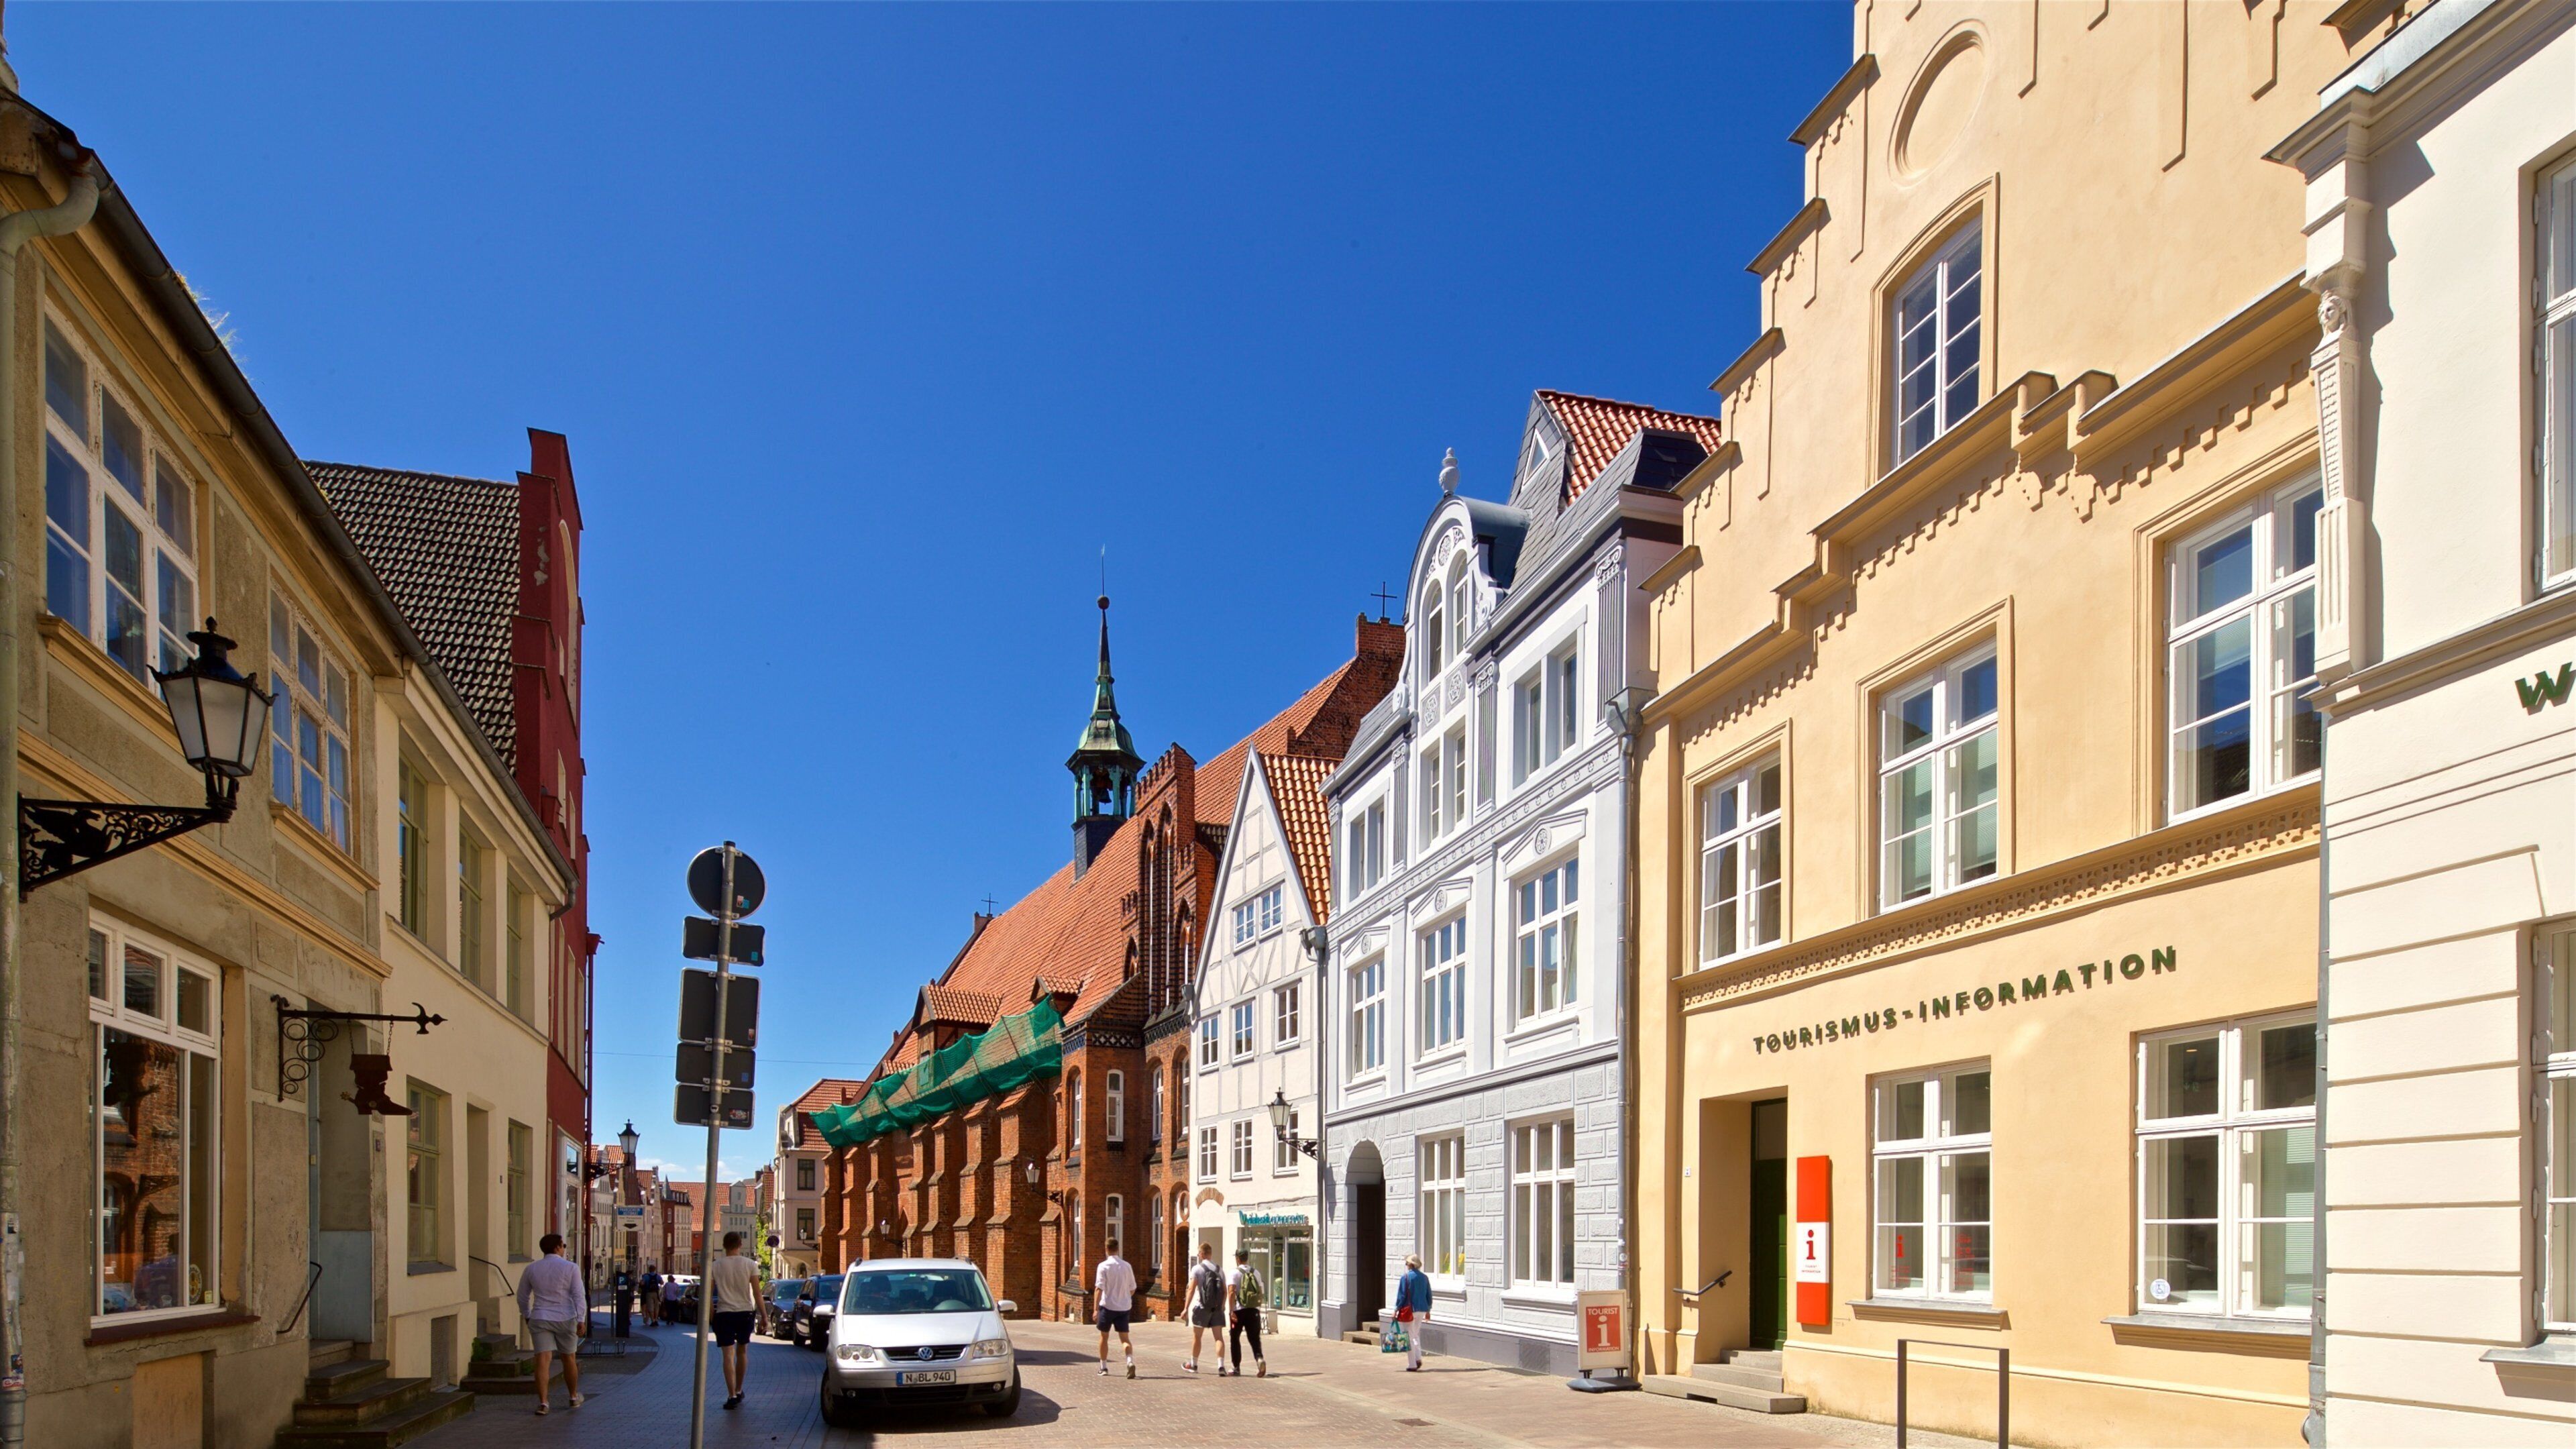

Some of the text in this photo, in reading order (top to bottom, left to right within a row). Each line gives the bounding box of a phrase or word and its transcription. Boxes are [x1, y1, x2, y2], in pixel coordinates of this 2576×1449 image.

[1753, 945, 2176, 1054] TOURISMUS-INFORMATION
[906, 1371, 951, 1383] N BL 940
